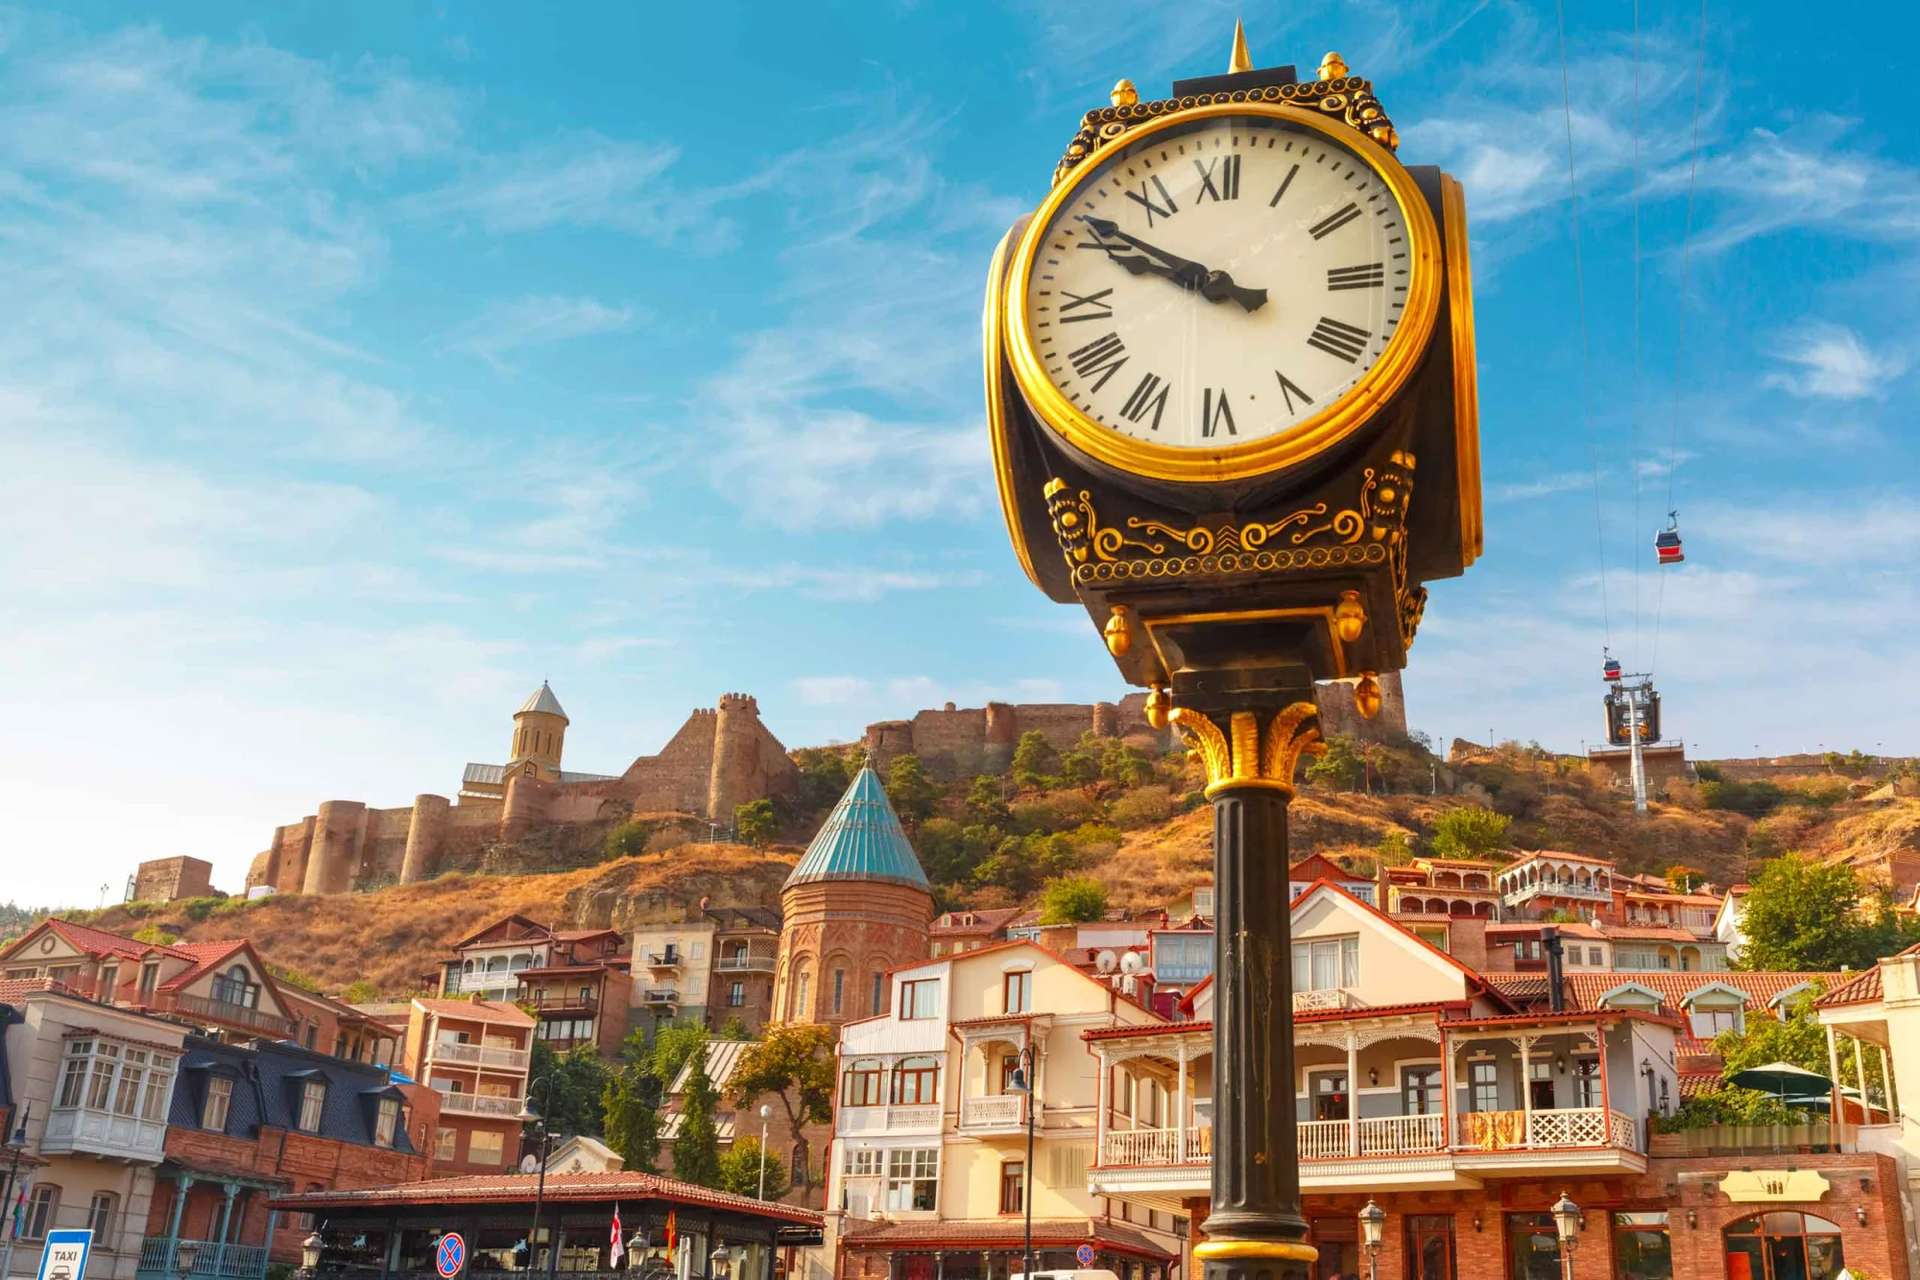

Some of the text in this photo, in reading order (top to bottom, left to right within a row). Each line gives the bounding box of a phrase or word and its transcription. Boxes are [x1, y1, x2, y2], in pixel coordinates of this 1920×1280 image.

[1125, 174, 1178, 228] XI
[1194, 154, 1241, 205] XII
[1270, 164, 1300, 208] I
[1077, 228, 1133, 256] X
[1308, 202, 1362, 241] II
[1328, 262, 1384, 291] III
[1060, 288, 1113, 324] IX
[1068, 331, 1130, 394] VIII
[1307, 316, 1372, 364] IIII
[1119, 372, 1171, 431] VII
[1202, 388, 1237, 437] VI
[1275, 370, 1314, 416] V
[54, 1251, 77, 1261] TAXI
